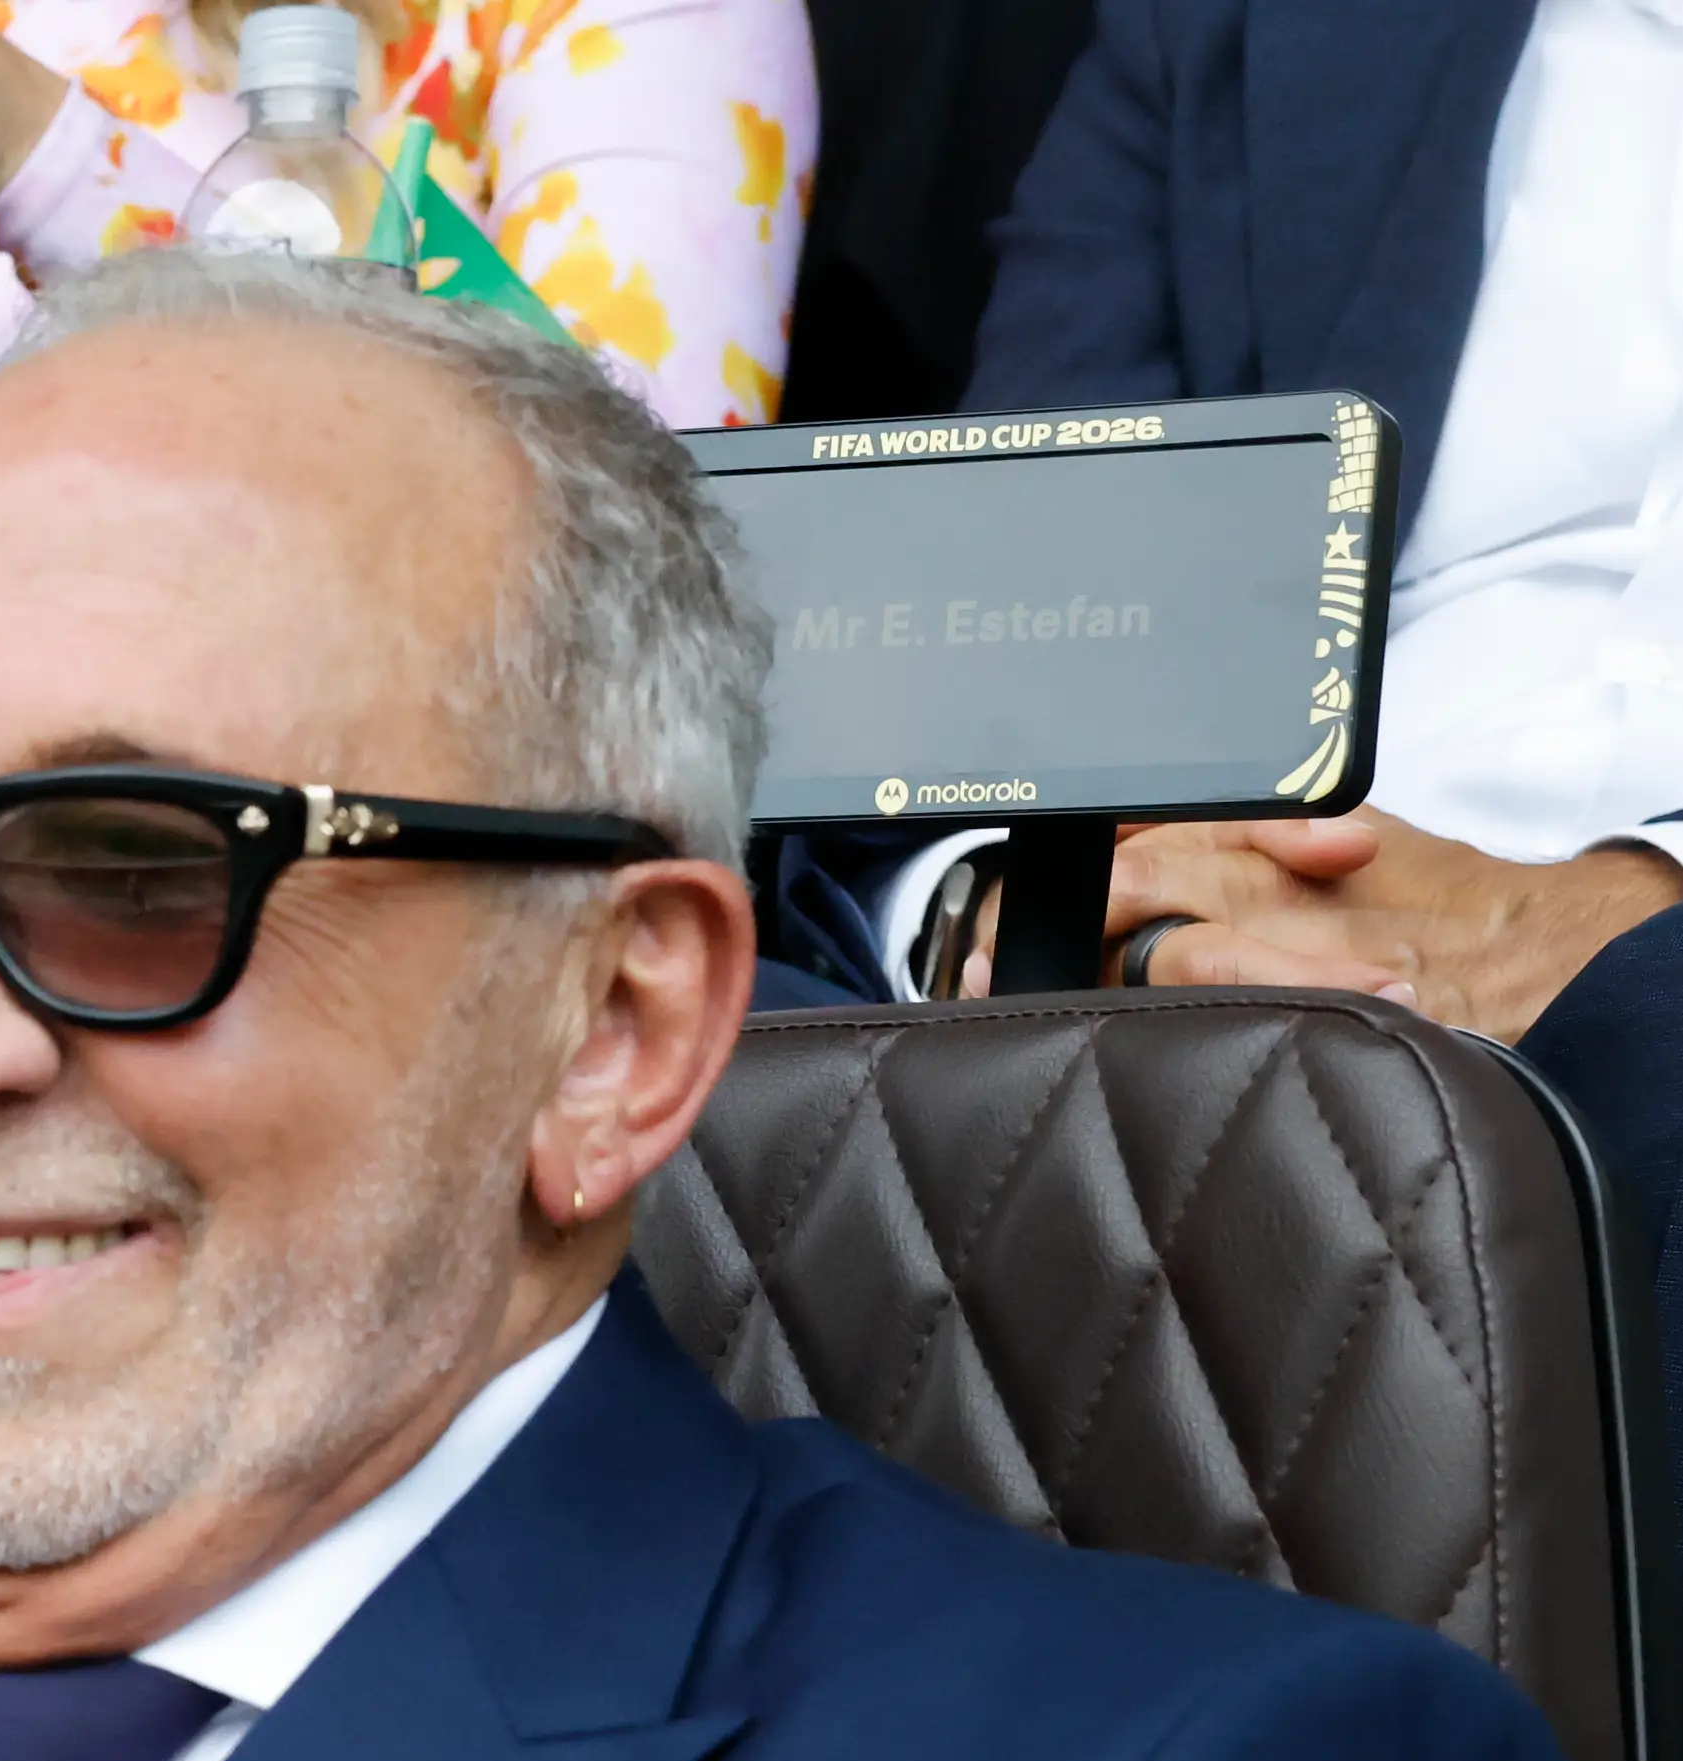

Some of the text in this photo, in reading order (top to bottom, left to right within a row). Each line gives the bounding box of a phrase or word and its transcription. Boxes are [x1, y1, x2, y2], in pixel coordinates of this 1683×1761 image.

[812, 416, 1164, 459] FIFA WORLD CUP 2026
[791, 595, 1151, 650] Mr E. Estefan
[916, 778, 1037, 804] motorola
